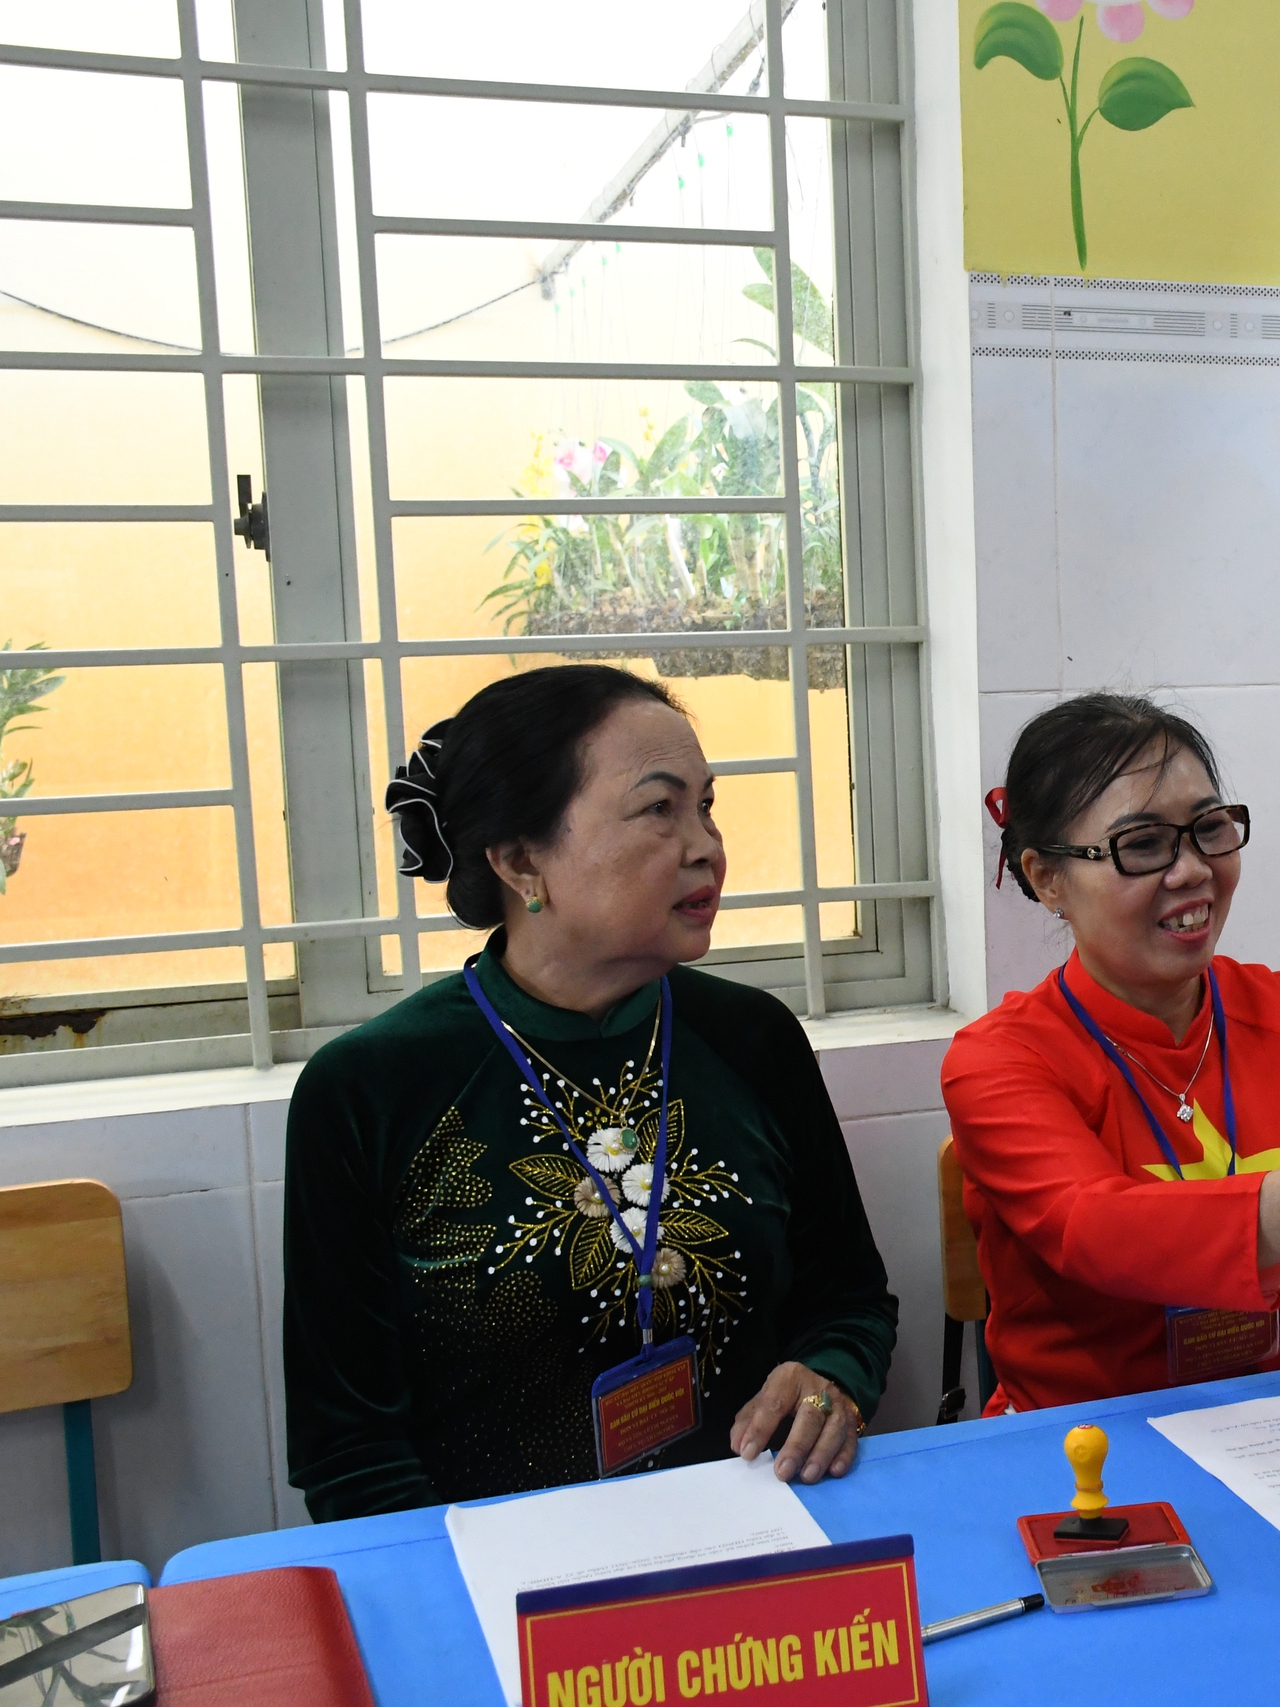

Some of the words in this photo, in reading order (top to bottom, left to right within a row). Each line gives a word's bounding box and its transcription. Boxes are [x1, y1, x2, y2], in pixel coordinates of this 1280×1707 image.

[547, 1646, 666, 1707] NGƯỜI
[676, 1632, 804, 1699] CHỨNG
[812, 1607, 899, 1678] KIẾN
